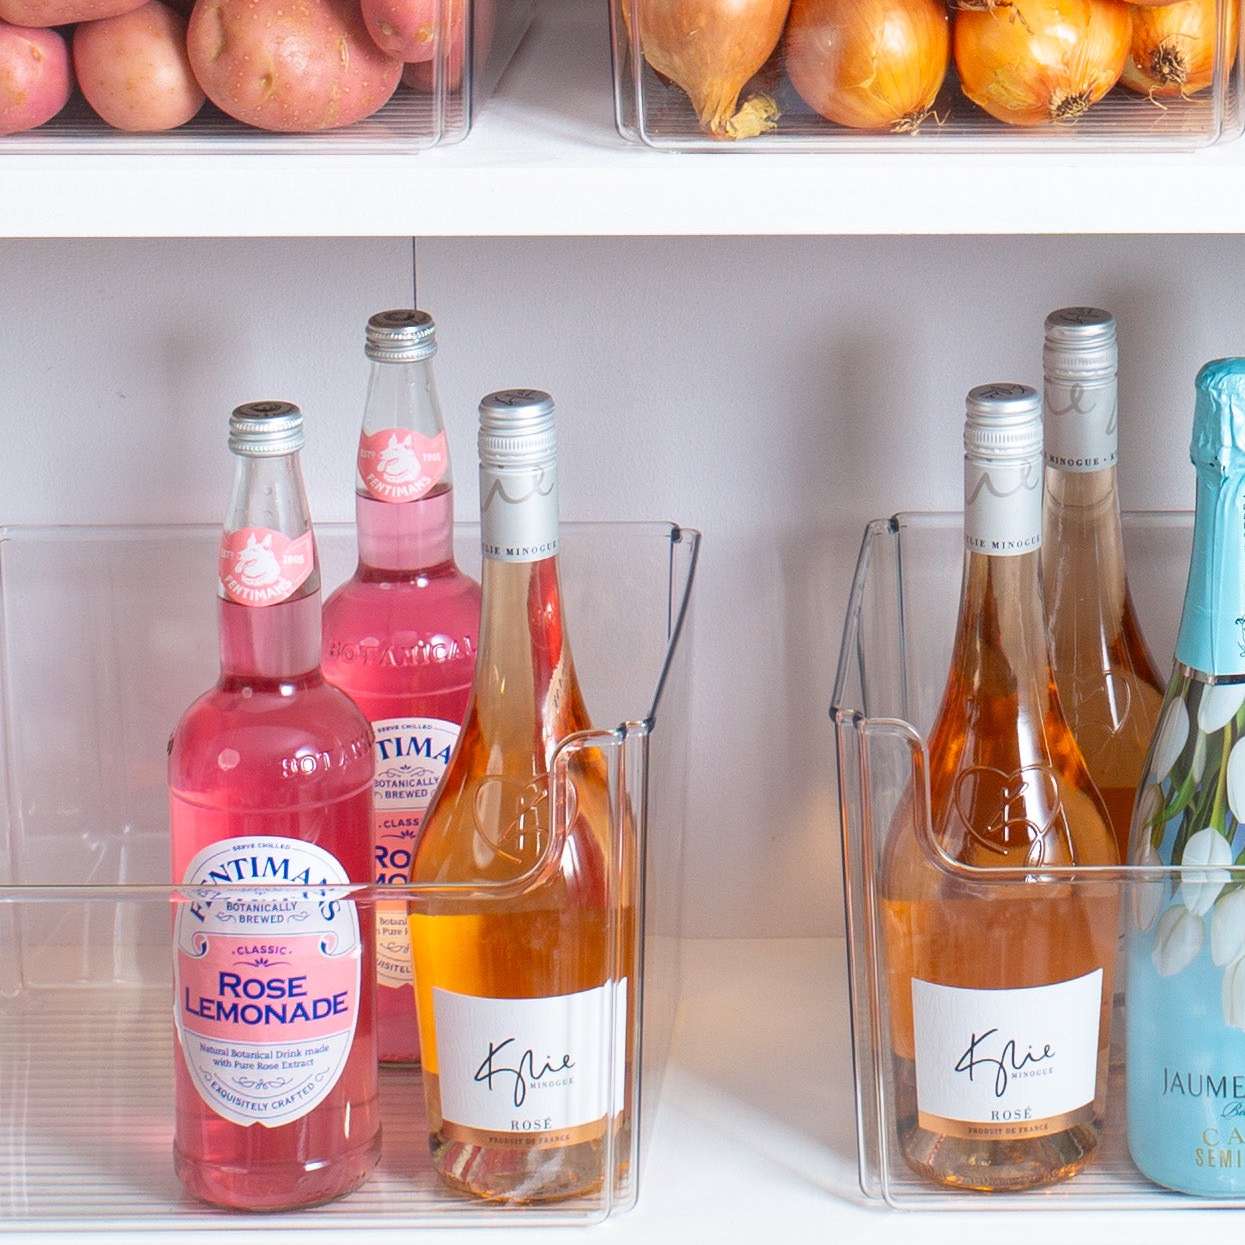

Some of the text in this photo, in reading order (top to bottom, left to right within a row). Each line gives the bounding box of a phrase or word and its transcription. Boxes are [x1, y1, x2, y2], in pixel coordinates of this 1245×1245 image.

[367, 475, 432, 498] FENTIMANS
[223, 575, 292, 602] FENTIMANS
[385, 790, 428, 799] BREWED
[226, 900, 298, 912] BOTANICALLY
[239, 914, 284, 924] BREWED
[236, 945, 287, 956] CLASSIC
[218, 970, 308, 999] ROSE
[185, 986, 349, 1025] LEMONADE
[200, 1043, 330, 1060] Natural Botanical Drink made
[213, 1058, 314, 1070] with Pure Rose Extract
[954, 1028, 1056, 1098] Kylie
[474, 1038, 576, 1107] Kylie
[1011, 1067, 1053, 1079] MINOGUE
[530, 1077, 575, 1089] MINOGUE
[1161, 1067, 1245, 1099] JAUME
[210, 1080, 315, 1112] EXQUISITELY CRAFTED
[991, 1107, 1032, 1121] ROSÉ
[511, 1117, 553, 1131] ROSÉ
[968, 1126, 1002, 1135] PRODUIT
[1018, 1124, 1049, 1134] FRANCE
[538, 1135, 570, 1144] FRANCE
[1195, 1147, 1242, 1168] SEMI
